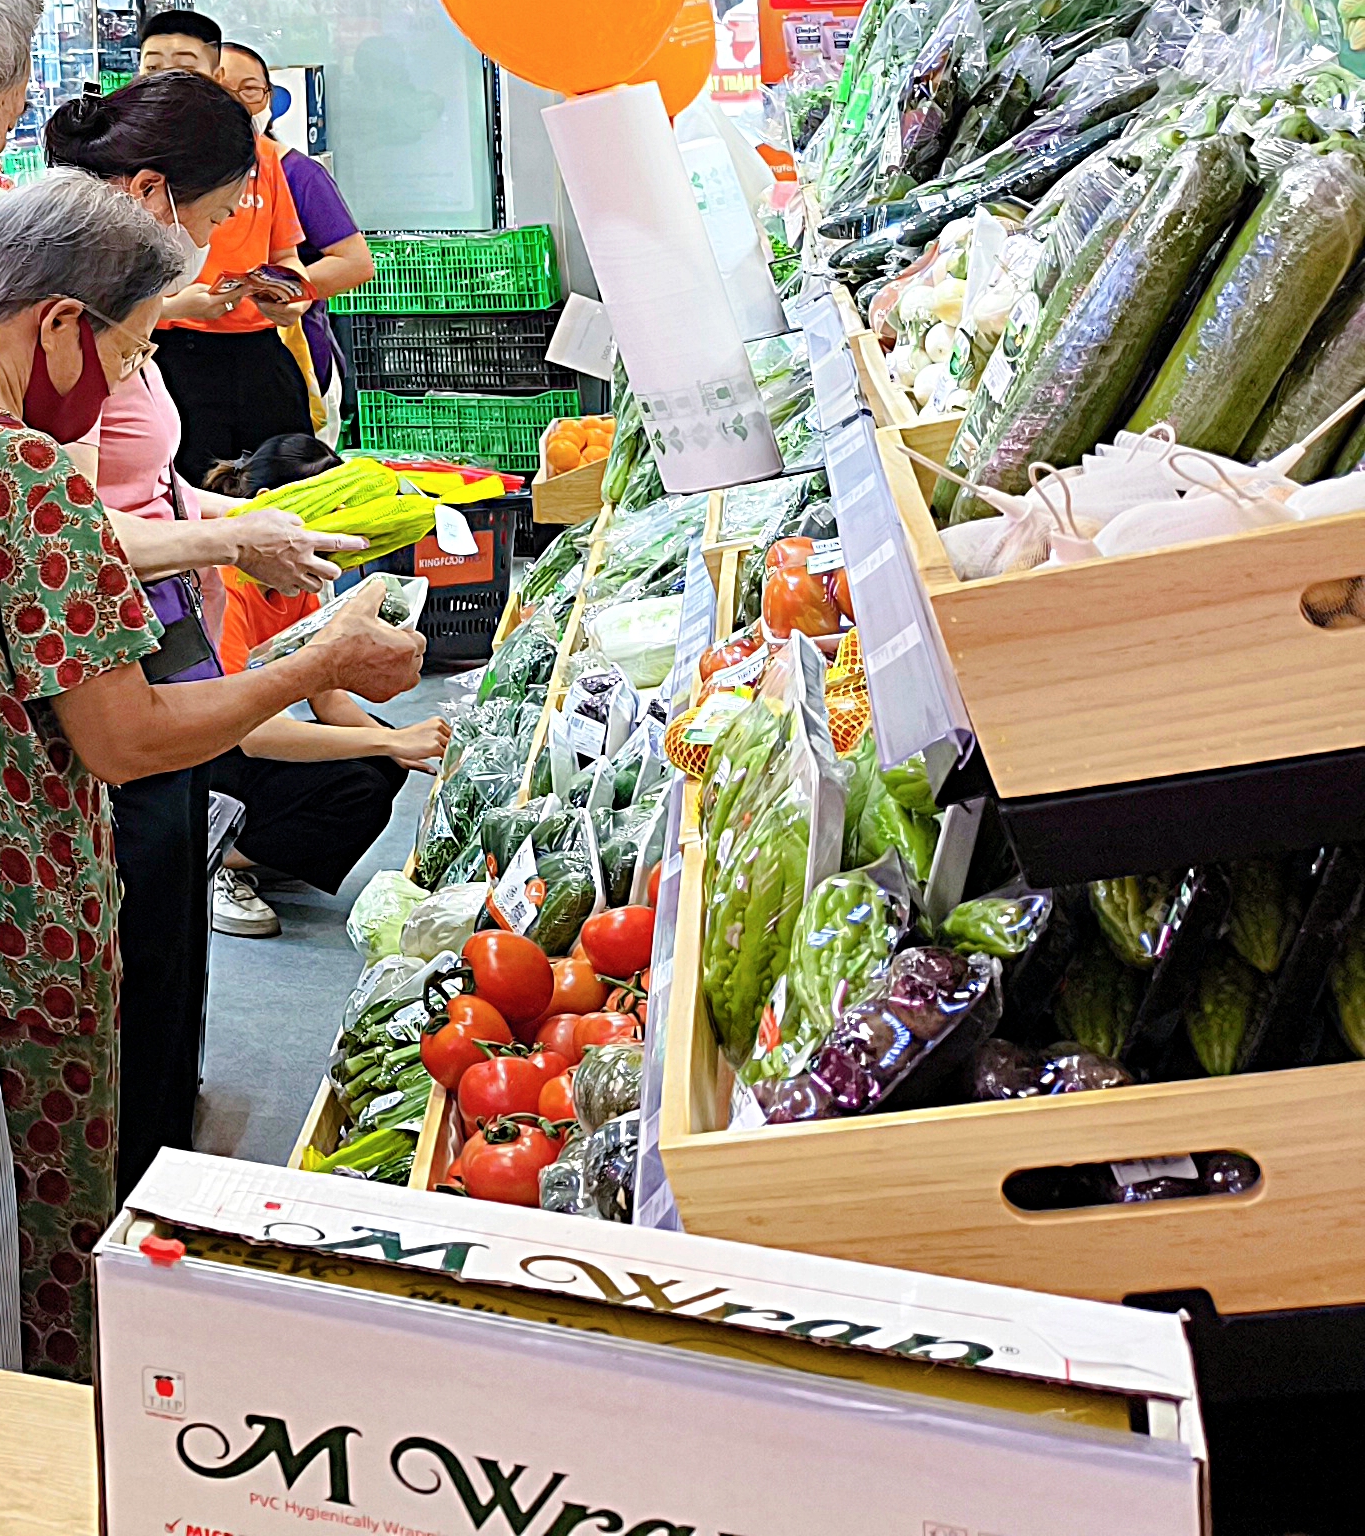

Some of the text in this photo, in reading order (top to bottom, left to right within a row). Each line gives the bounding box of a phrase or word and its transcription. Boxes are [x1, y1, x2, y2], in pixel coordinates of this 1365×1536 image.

[176, 1414, 363, 1507] M
[249, 1492, 380, 1533] PVC Hygienically
